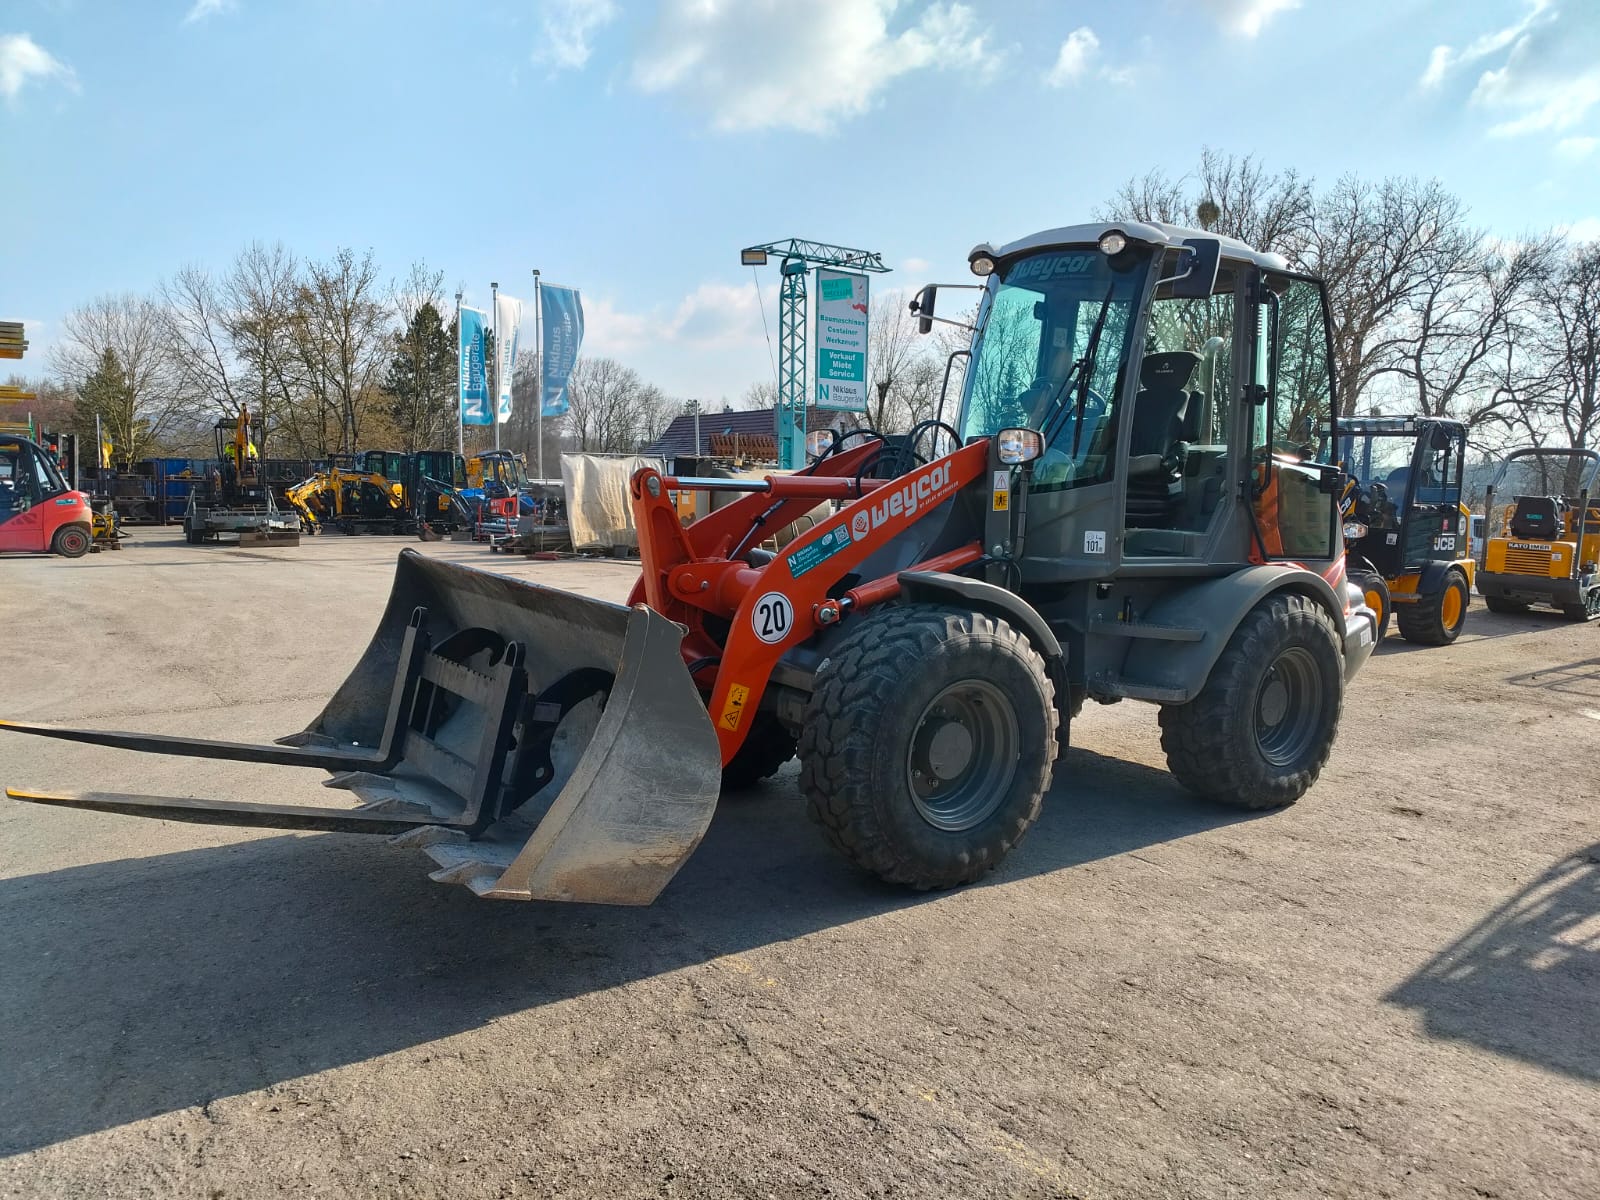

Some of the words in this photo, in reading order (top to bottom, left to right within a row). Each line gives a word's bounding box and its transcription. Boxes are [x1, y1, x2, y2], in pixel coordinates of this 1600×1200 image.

[1016, 255, 1096, 280] weycor
[820, 314, 865, 326] Baumaschinen
[827, 326, 858, 335] Container
[826, 336, 859, 347] Werkzeuge
[549, 327, 561, 377] Niklaus
[829, 351, 856, 361] Verkauf
[832, 360, 852, 370] Miete
[828, 368, 855, 378] Service
[819, 383, 829, 400] N
[832, 385, 857, 395] Niklaus
[463, 398, 484, 417] N
[871, 460, 952, 530] weycor
[1086, 540, 1099, 552] 101
[1433, 537, 1456, 551] JCB
[787, 555, 797, 567] N
[759, 600, 786, 636] 20
